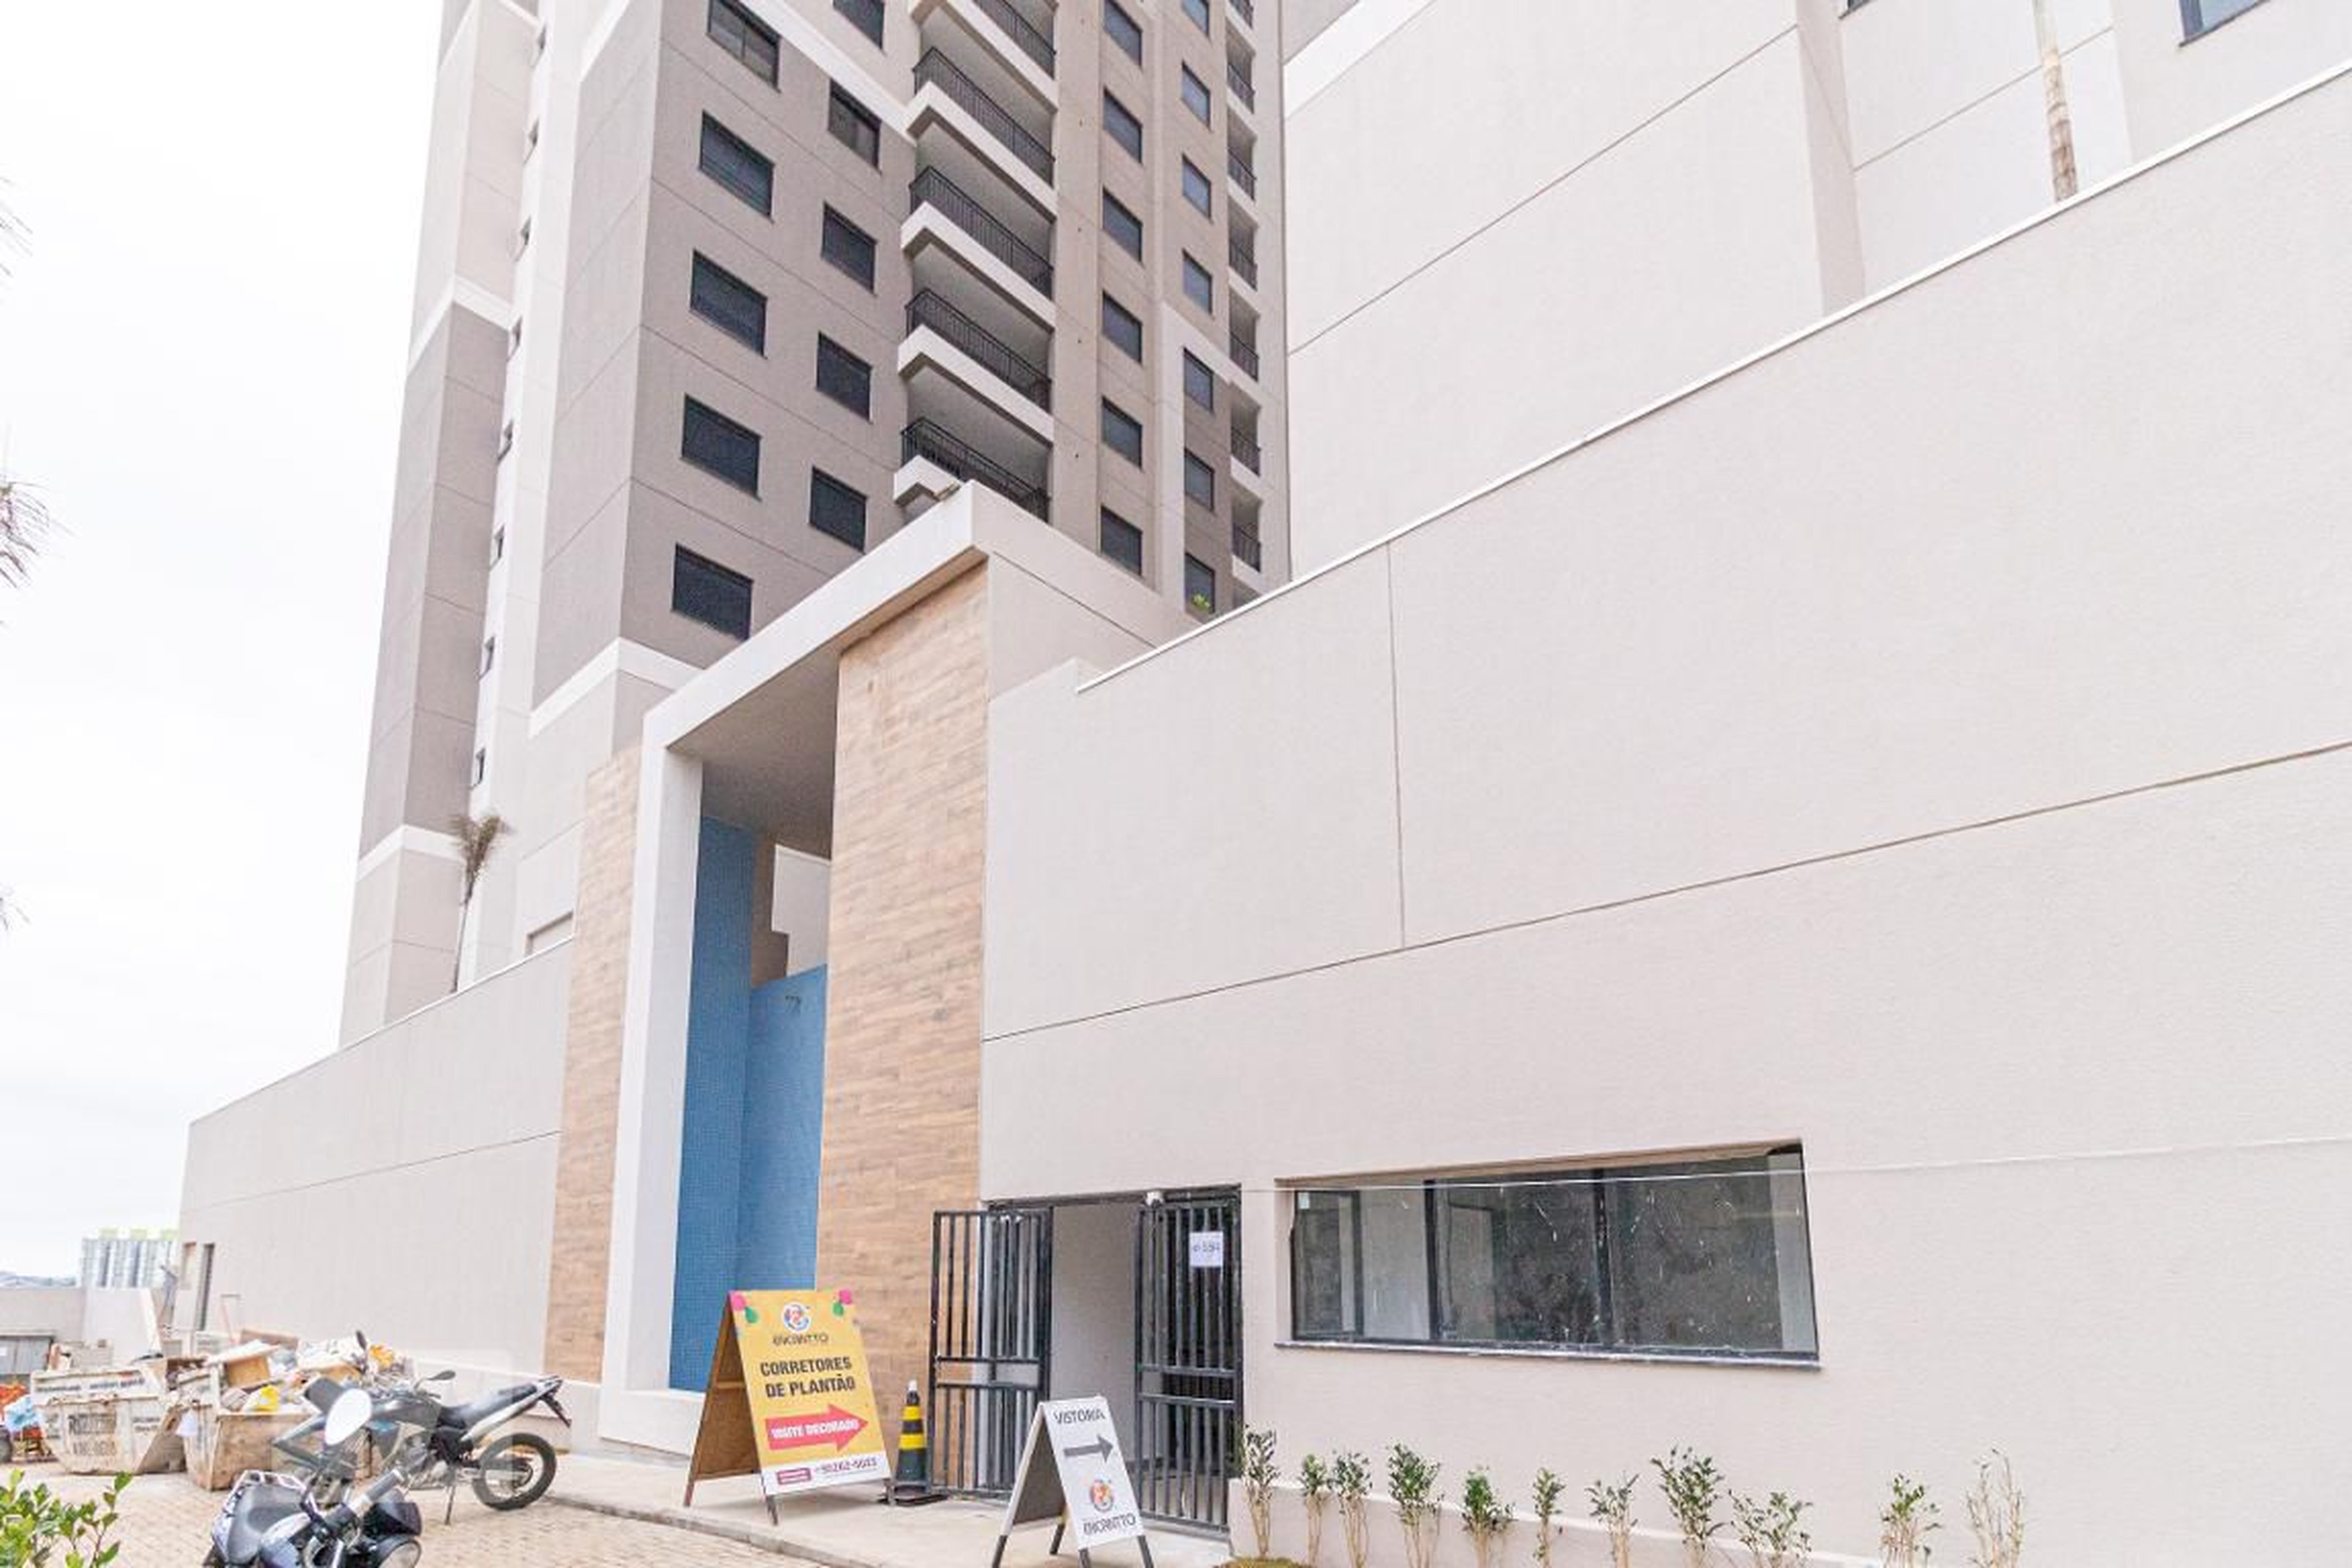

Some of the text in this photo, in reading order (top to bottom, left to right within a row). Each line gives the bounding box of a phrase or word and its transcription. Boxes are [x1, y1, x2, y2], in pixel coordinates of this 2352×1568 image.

[760, 1356, 852, 1376] CORRETORES
[766, 1373, 856, 1398] DE PLANTÃO
[1054, 1408, 1106, 1424] VISTORIA
